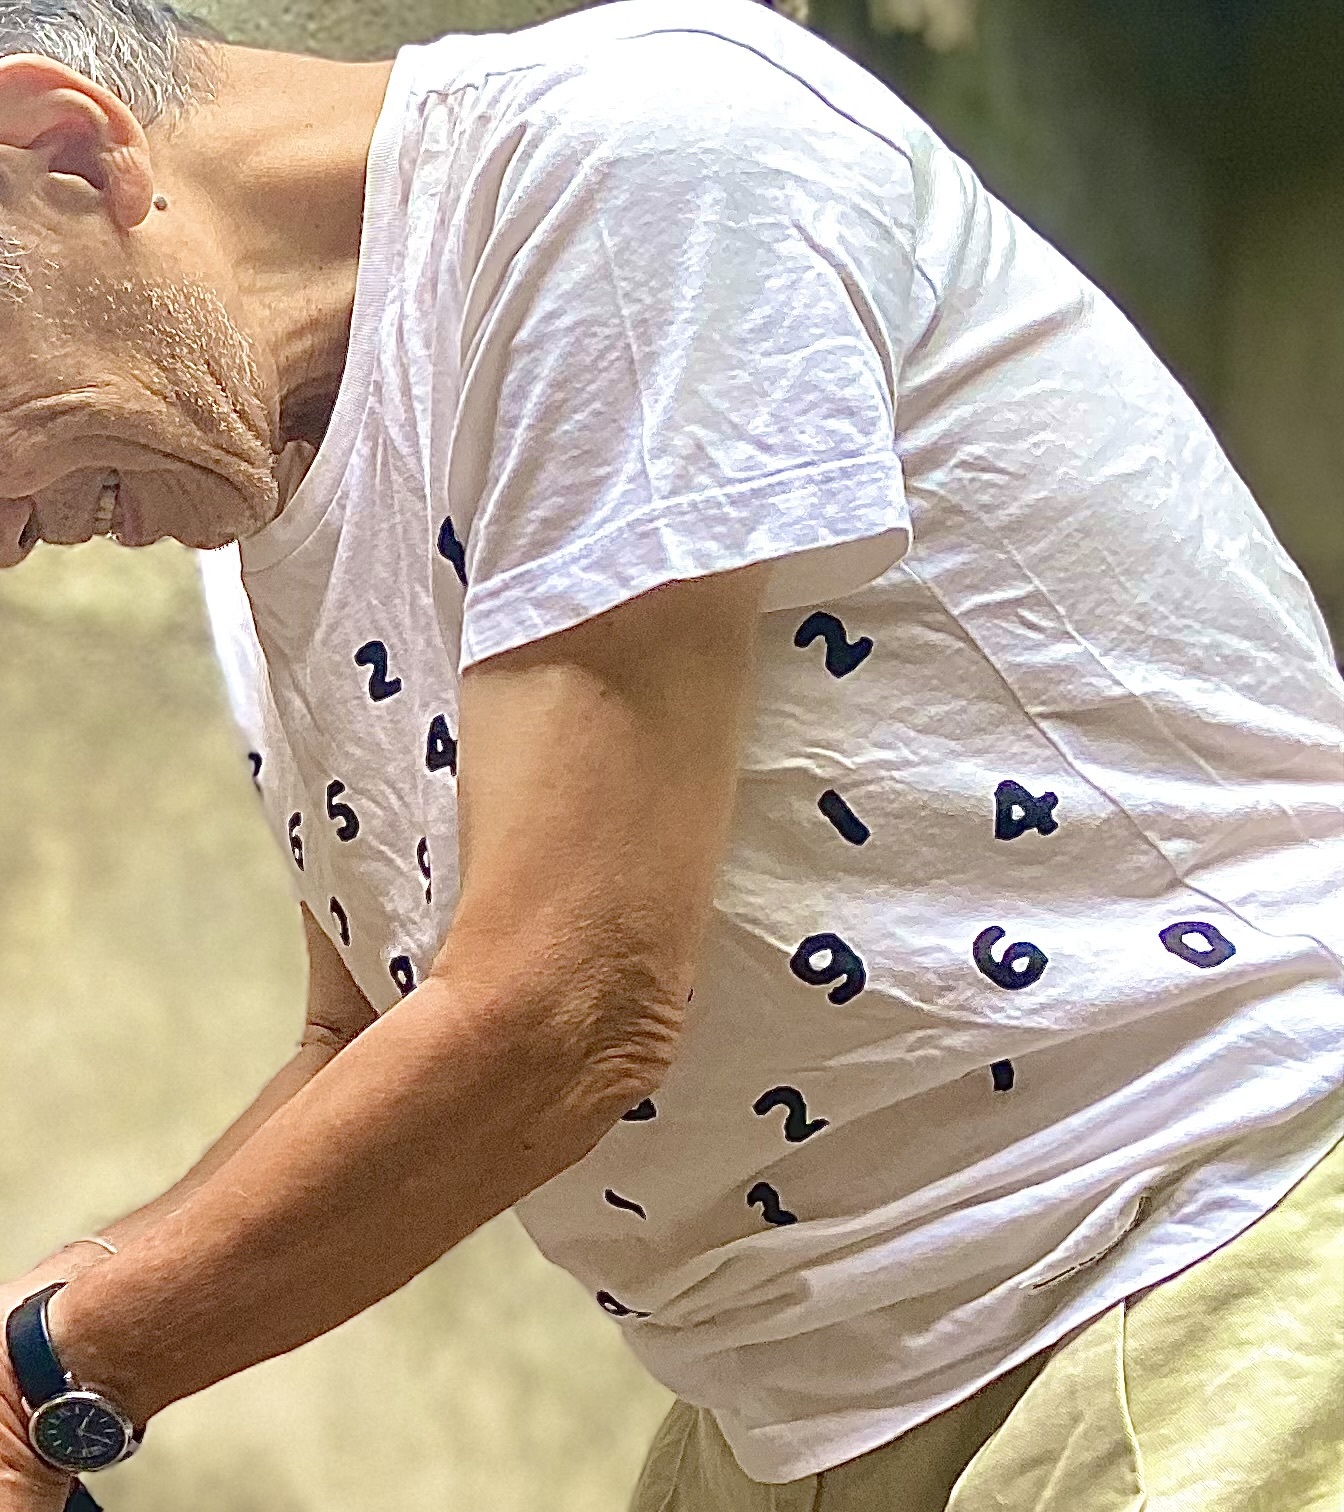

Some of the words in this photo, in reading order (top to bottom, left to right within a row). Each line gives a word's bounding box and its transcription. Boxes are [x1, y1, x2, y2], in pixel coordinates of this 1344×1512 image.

[354, 641, 401, 702] 2
[795, 611, 873, 677] 2
[426, 714, 457, 776] 4
[327, 780, 359, 841] 5
[818, 790, 870, 845] 1
[995, 780, 1058, 840] 4
[790, 933, 866, 1005] 9
[973, 926, 1048, 990] 6
[1159, 921, 1236, 968] 0
[753, 1086, 829, 1142] 2
